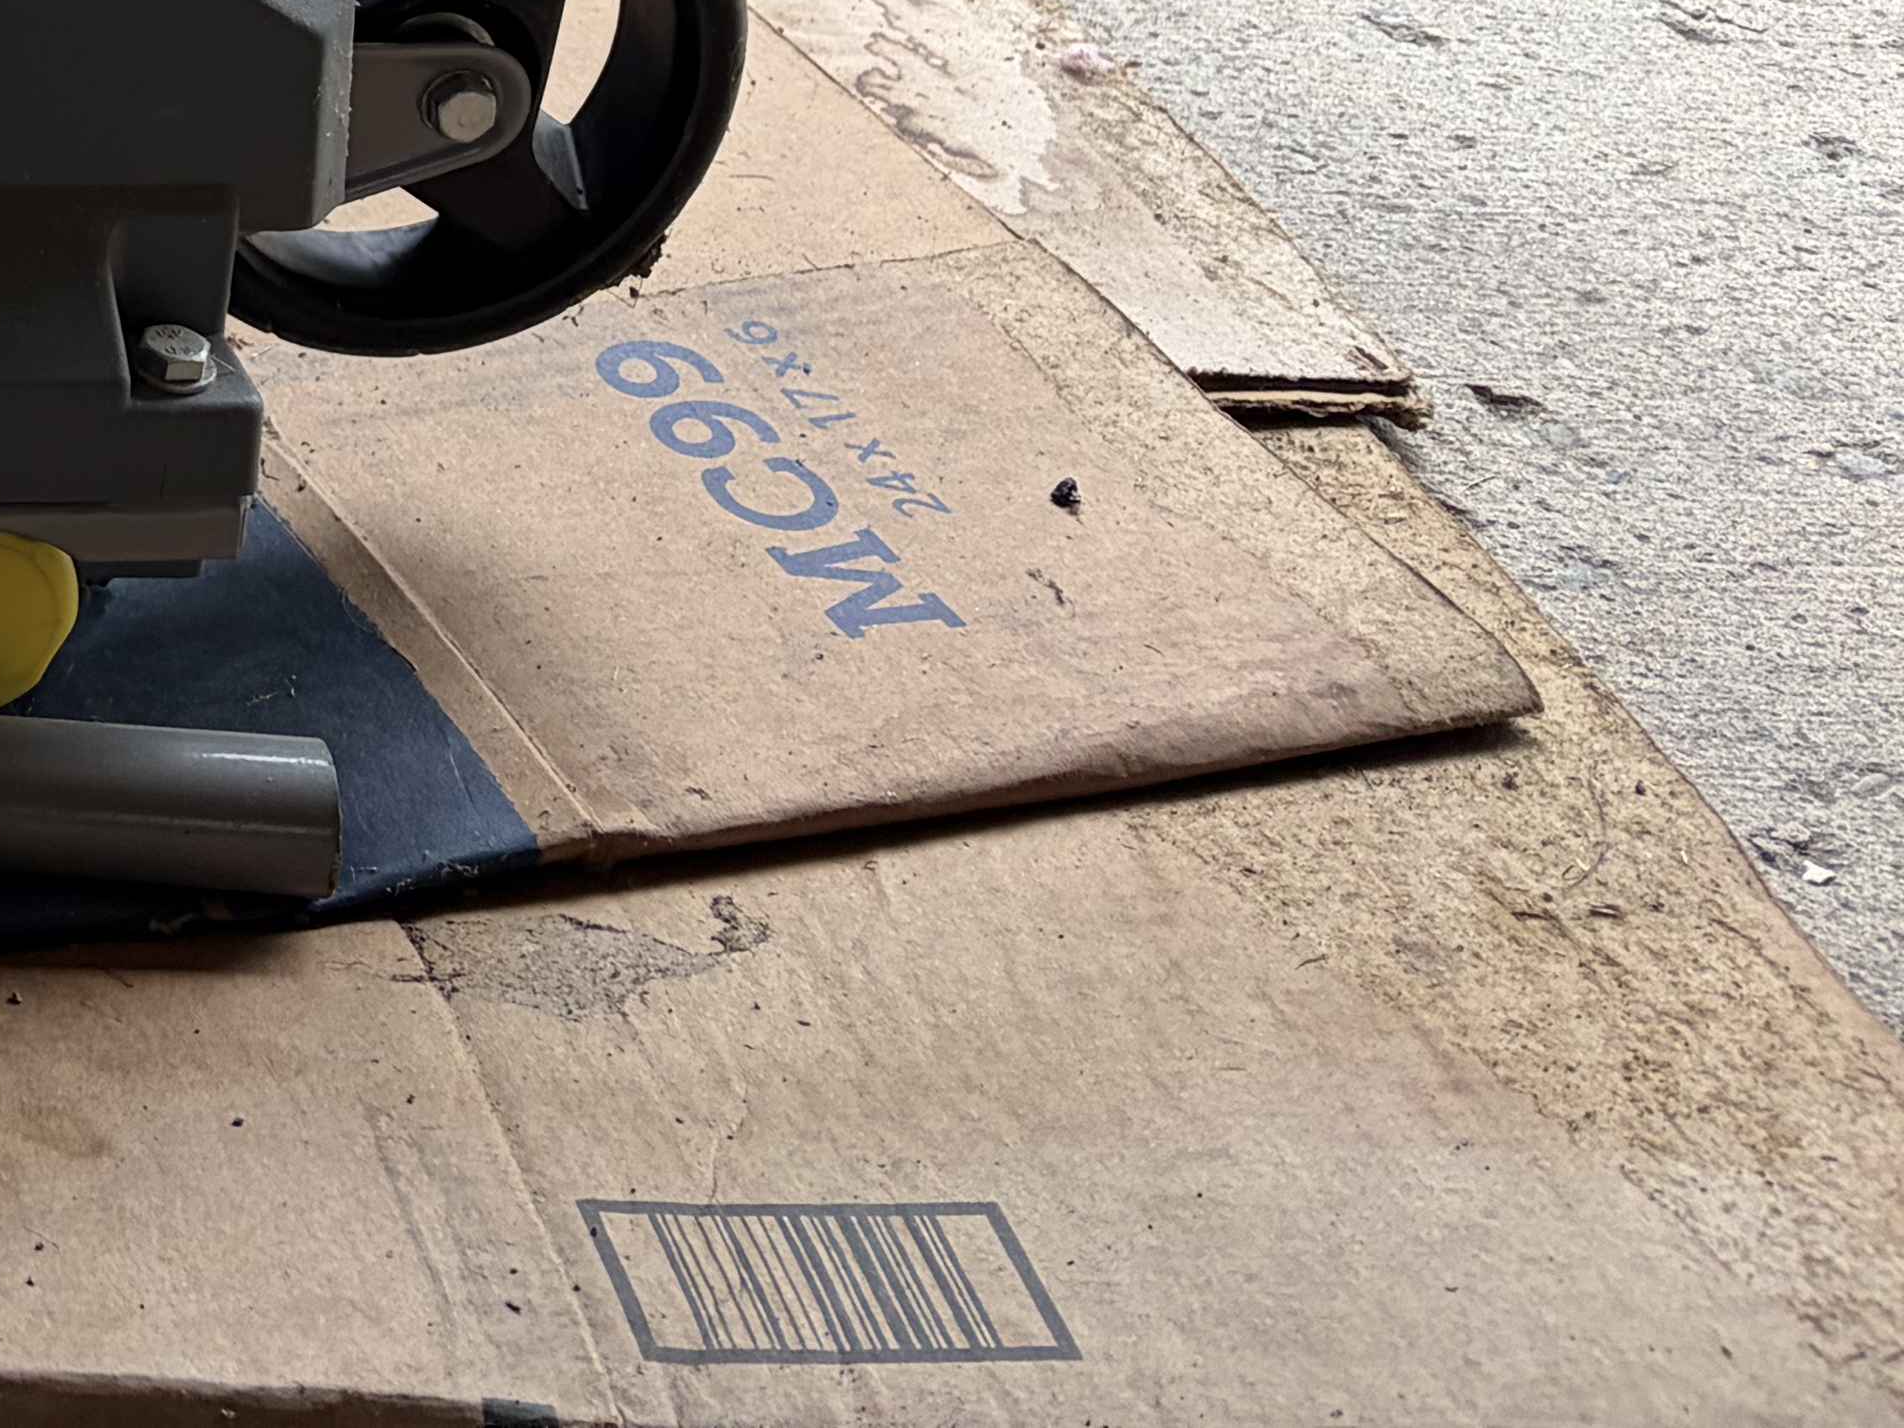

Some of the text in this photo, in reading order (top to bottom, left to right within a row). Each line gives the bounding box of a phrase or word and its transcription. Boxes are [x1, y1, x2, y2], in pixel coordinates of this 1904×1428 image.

[780, 387, 858, 430] 17
[595, 339, 969, 640] MC99
[865, 469, 954, 519] 24
